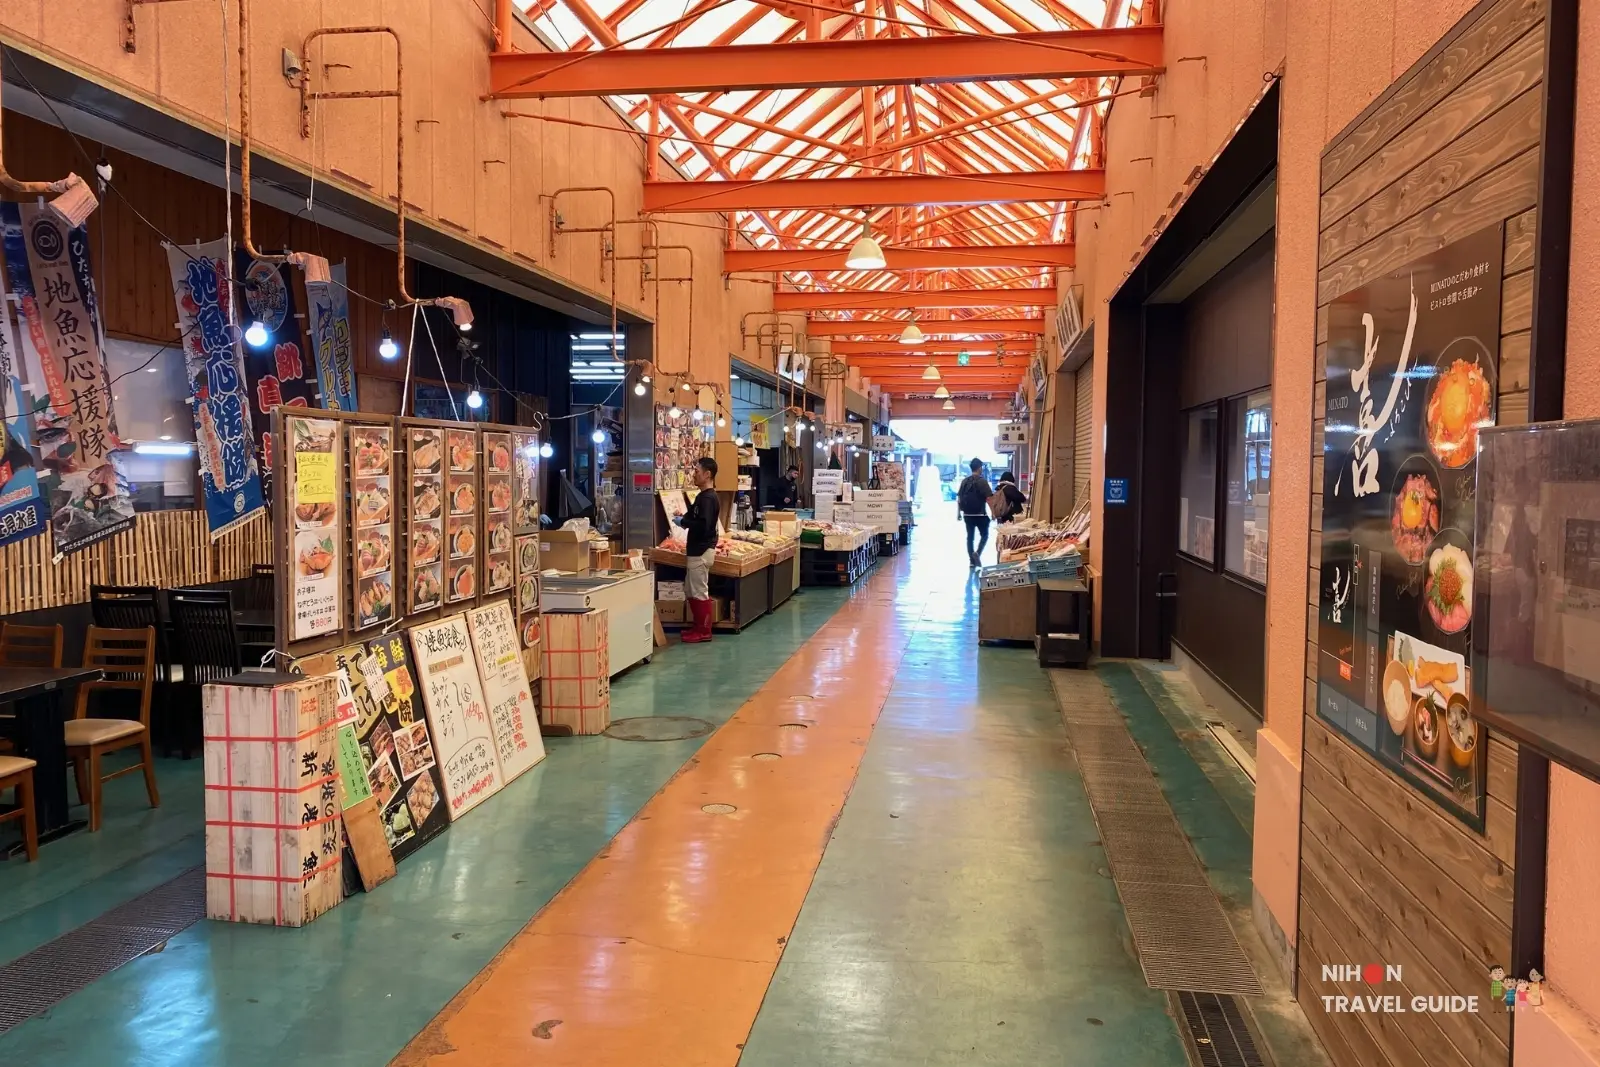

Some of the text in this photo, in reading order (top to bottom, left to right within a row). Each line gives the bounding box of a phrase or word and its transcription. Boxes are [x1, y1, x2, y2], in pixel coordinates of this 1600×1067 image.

[43, 272, 108, 463] 地魚応援隊
[186, 256, 246, 488] 地魚応援隊
[1327, 396, 1349, 411] MINATO
[301, 750, 319, 889] 新巻鮭
